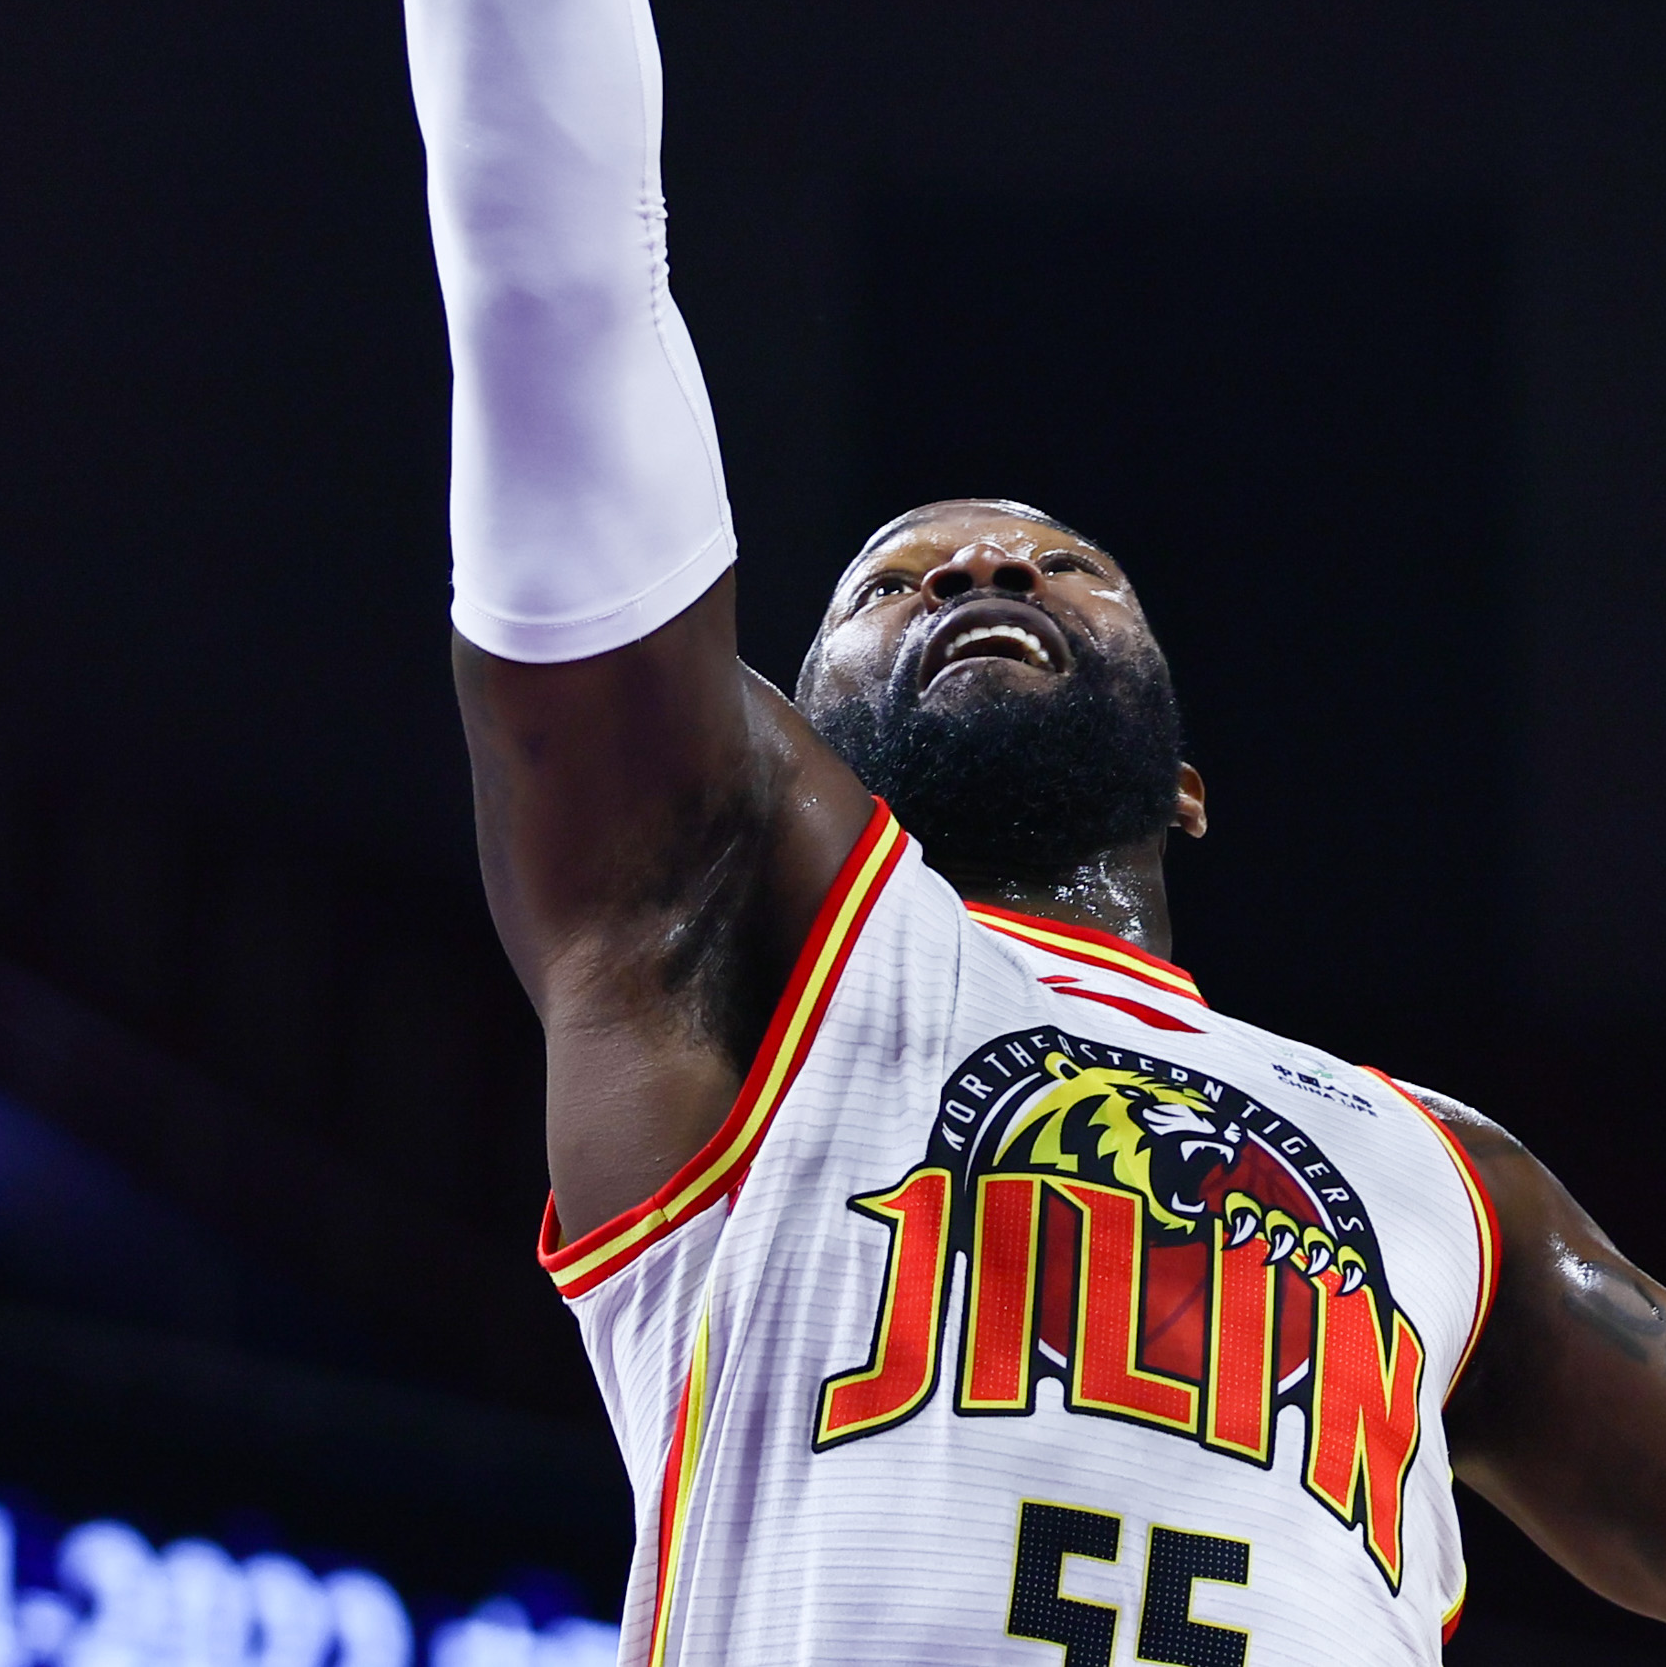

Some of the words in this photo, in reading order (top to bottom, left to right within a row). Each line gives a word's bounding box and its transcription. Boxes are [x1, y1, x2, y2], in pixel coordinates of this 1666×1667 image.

[942, 1033, 1223, 1151] NORTHEASTERN
[1241, 1100, 1365, 1233] TIGERS
[1278, 1075, 1336, 1102] CHINA
[1340, 1098, 1378, 1118] LIFE
[814, 1166, 1426, 1596] JILIN
[1005, 1497, 1252, 1667] 55
